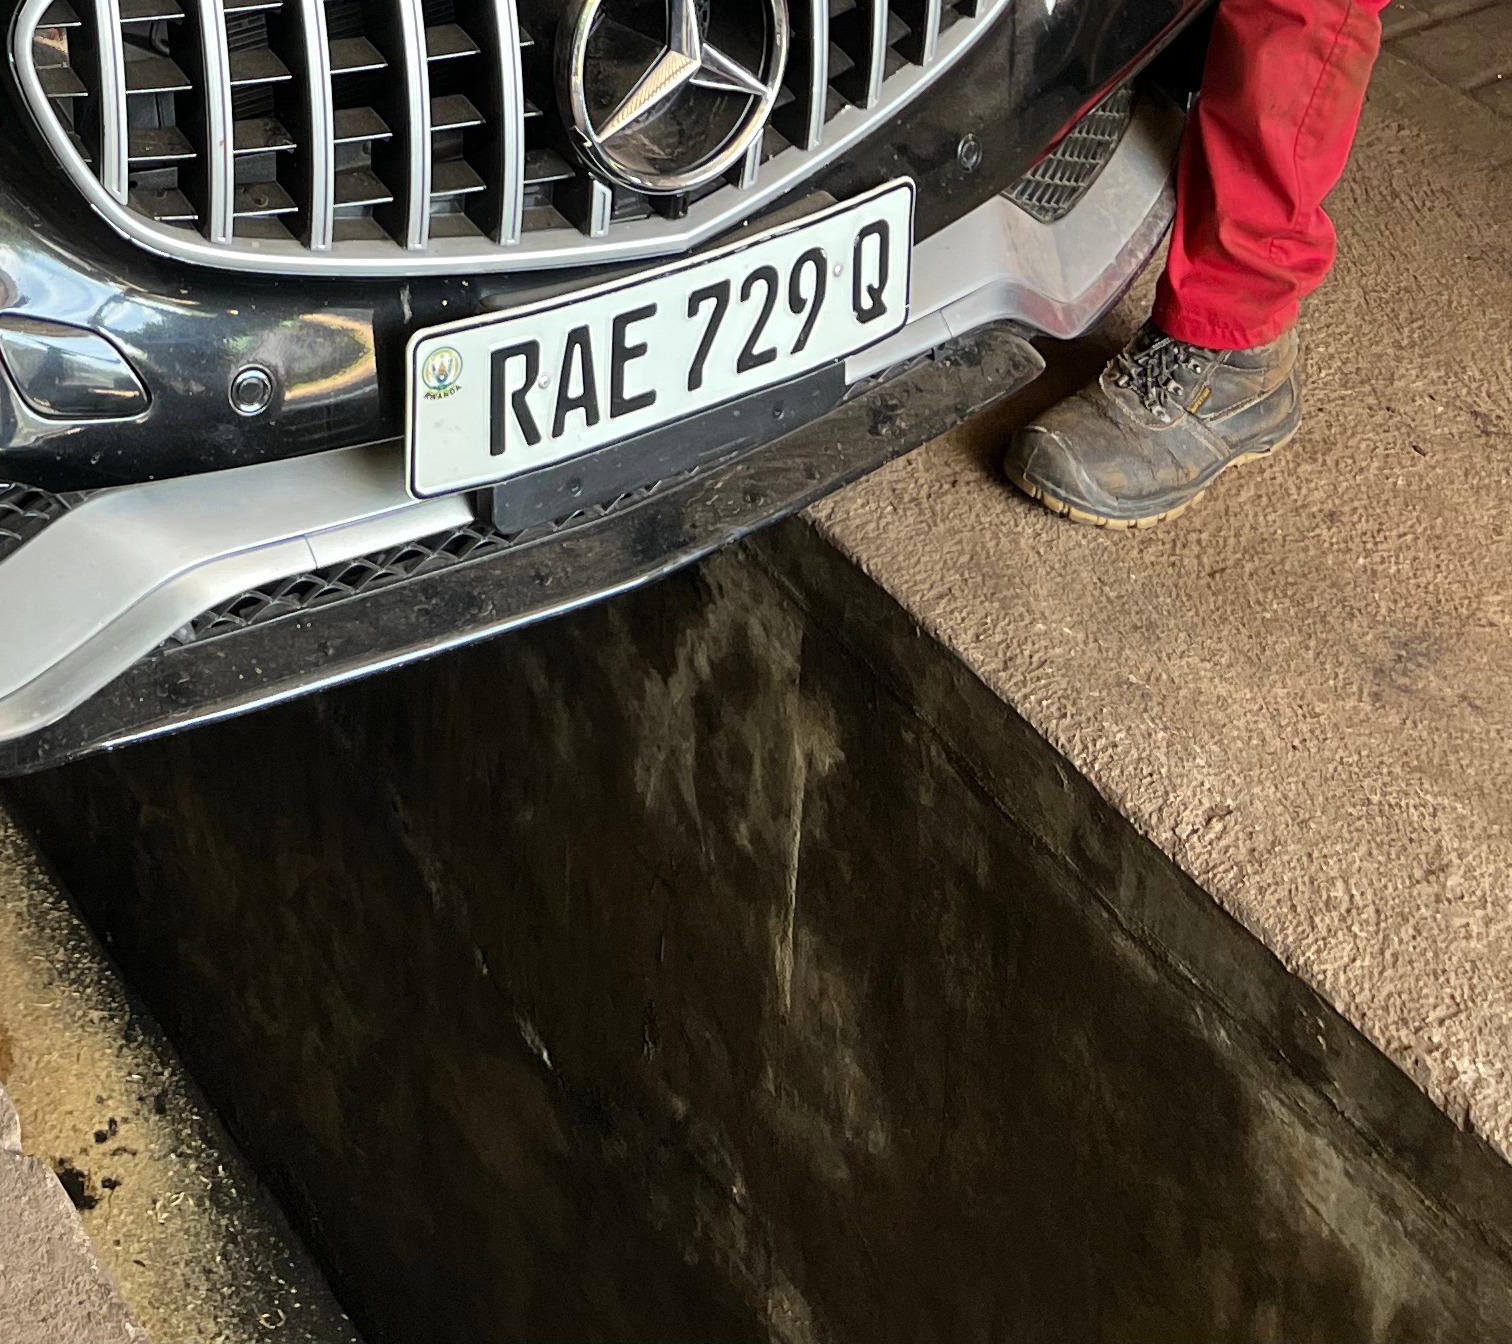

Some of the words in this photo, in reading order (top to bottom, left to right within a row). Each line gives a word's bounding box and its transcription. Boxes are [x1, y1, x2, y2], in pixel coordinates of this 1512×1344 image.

[424, 385, 462, 400] RWANDA
[490, 303, 657, 457] RAE
[688, 247, 828, 392] 729
[853, 219, 889, 324] Q
